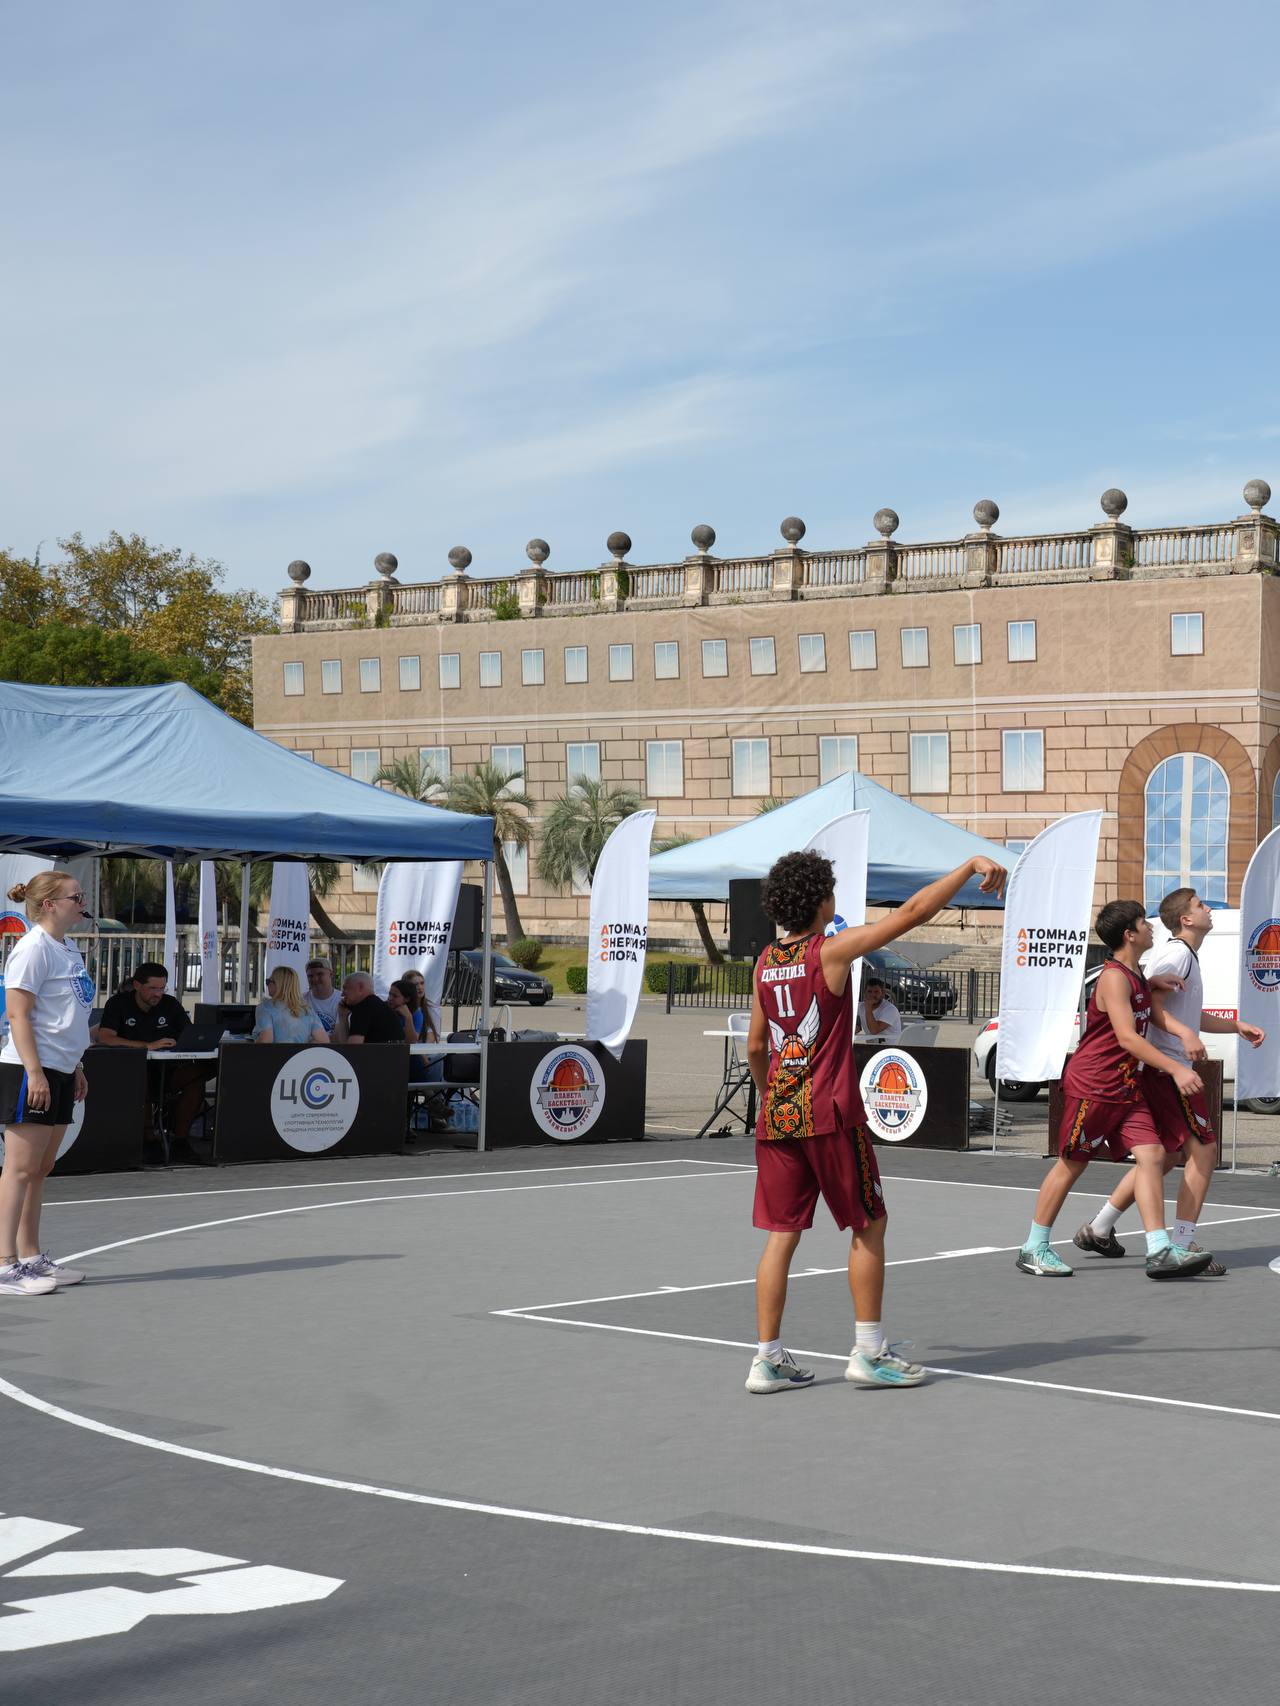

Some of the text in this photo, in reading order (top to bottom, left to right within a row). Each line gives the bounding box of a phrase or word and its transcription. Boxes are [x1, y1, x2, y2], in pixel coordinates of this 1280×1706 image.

[272, 918, 307, 931] АОМНАЯ
[389, 921, 452, 932] АТОМНАЯ
[271, 930, 306, 942] ЭЕРГИЯ
[390, 933, 448, 944] ЭНЕРГИЯ
[1017, 928, 1087, 942] АТОМНАЯ
[601, 937, 646, 950] ЭНЕРИЯ
[1017, 942, 1083, 955] ЭНЕРГИЯ
[388, 945, 436, 956] СПОРТА
[1016, 955, 1074, 968] СПОРТА
[773, 984, 796, 1018] 11
